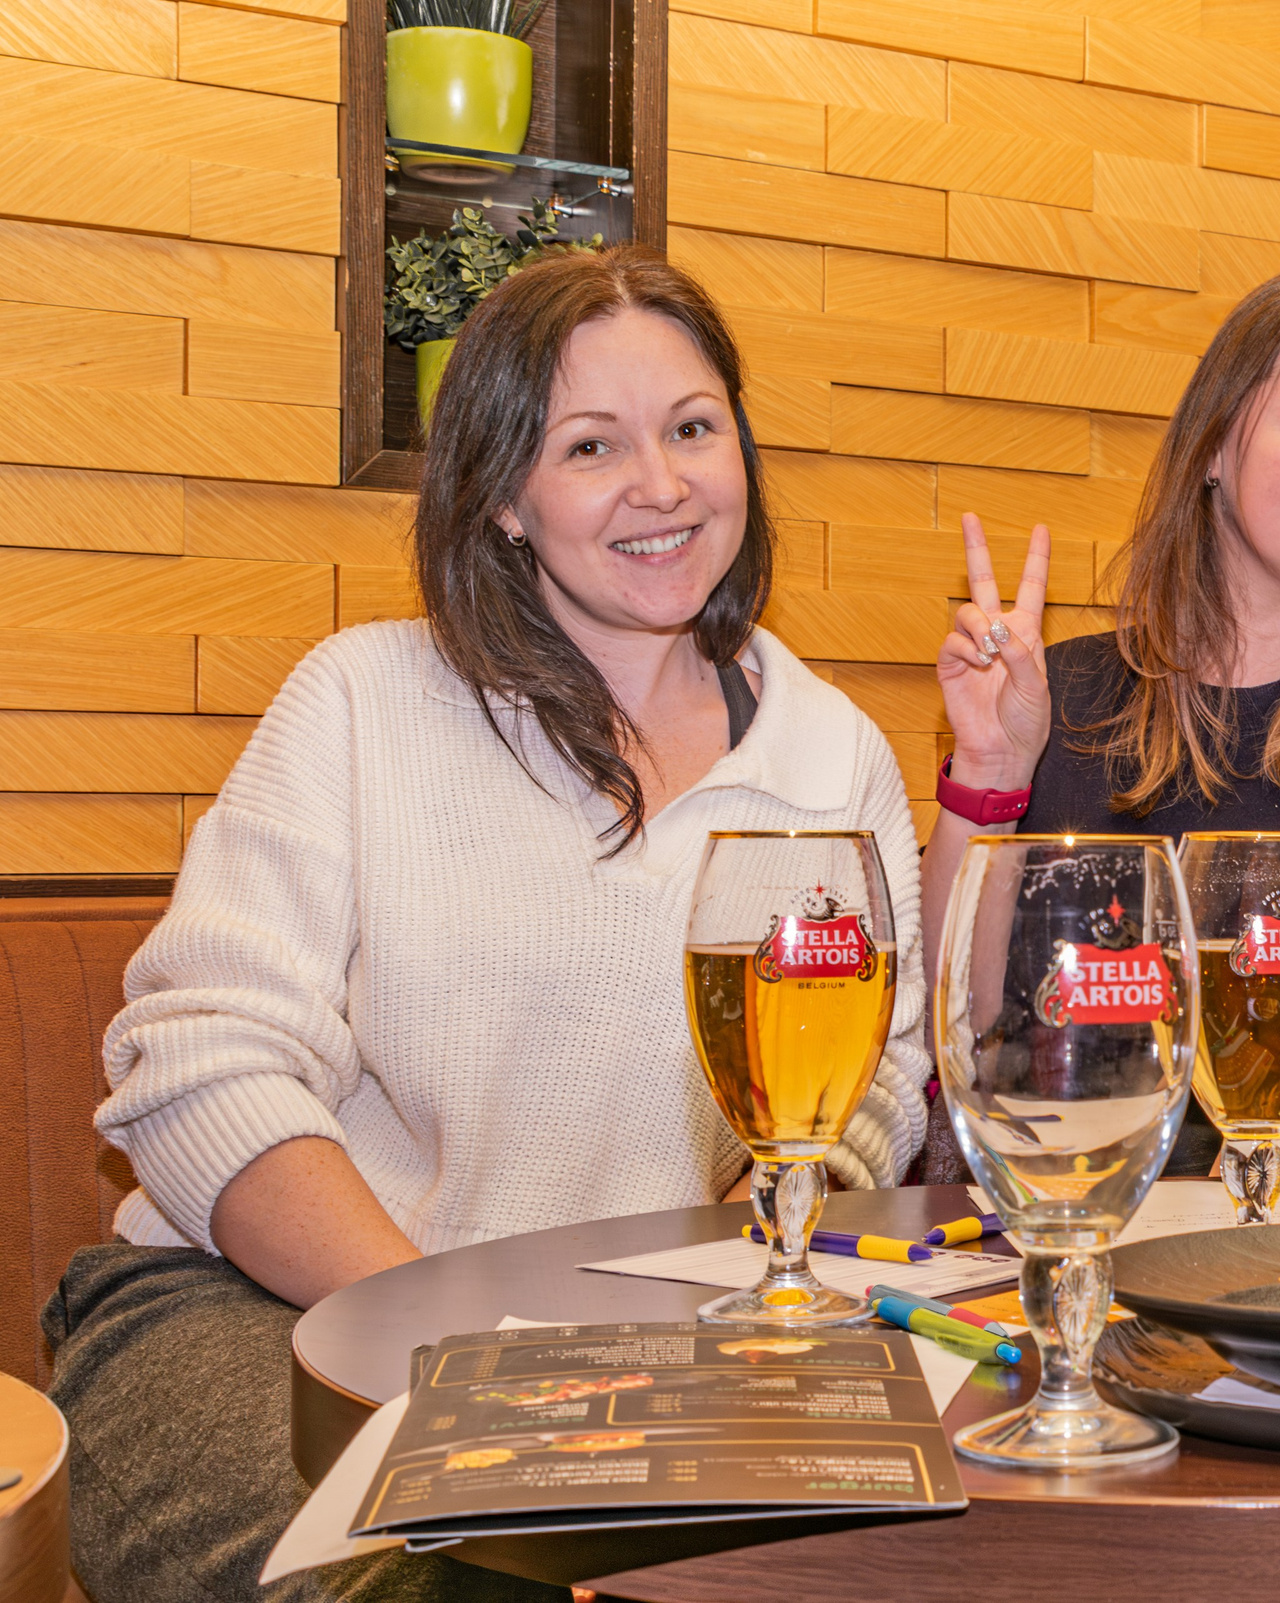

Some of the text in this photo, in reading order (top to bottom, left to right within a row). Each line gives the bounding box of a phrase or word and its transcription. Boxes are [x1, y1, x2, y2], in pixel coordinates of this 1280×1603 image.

[781, 929, 859, 946] STELLA
[780, 948, 860, 965] ARTOIS
[1069, 960, 1162, 983] STELLA
[1070, 984, 1163, 1006] ARTOIS
